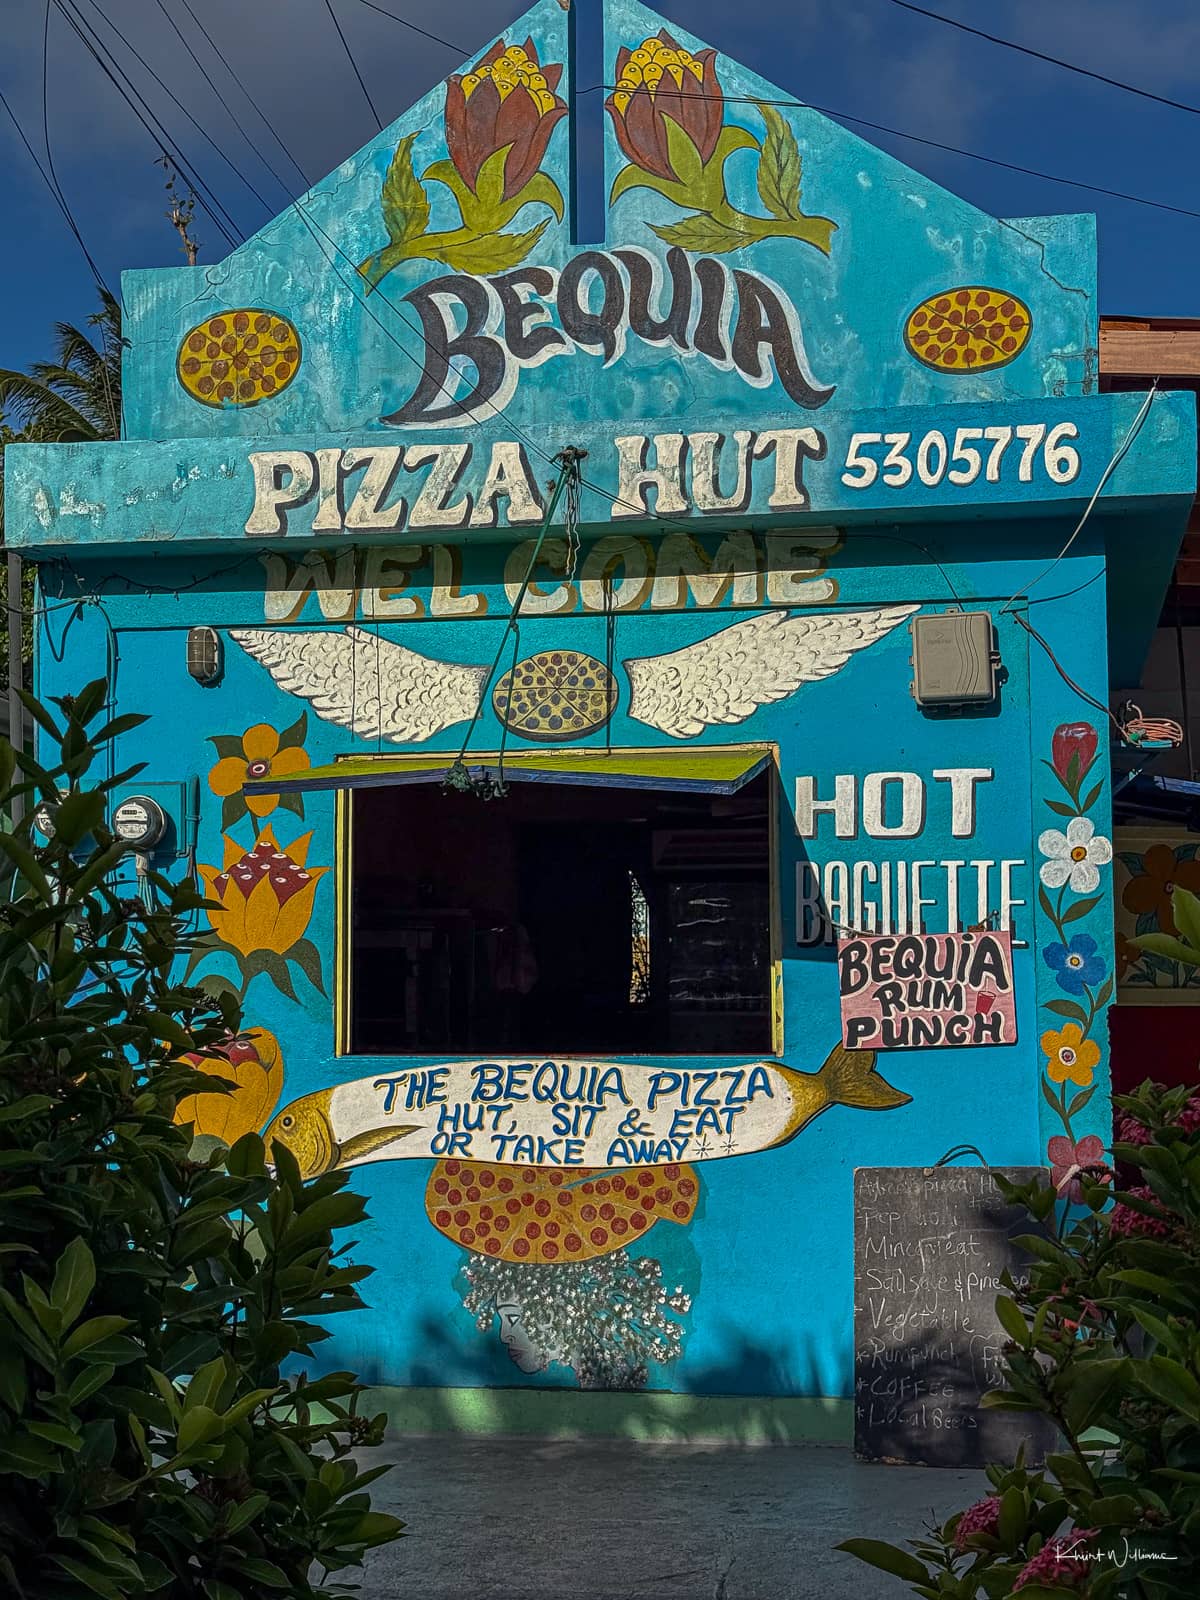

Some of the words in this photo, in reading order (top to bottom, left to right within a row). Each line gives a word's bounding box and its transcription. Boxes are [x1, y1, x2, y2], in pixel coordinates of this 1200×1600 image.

[379, 245, 837, 429] BEQUIA
[245, 442, 549, 535] PIZZA
[610, 427, 828, 520] HUT
[841, 422, 1082, 489] 5305776
[258, 527, 846, 621] WELCOME
[794, 767, 994, 839] HOT
[795, 859, 1026, 947] BAGUETTE
[845, 1010, 1009, 1048] PUNCH
[871, 980, 967, 1018] RUM
[373, 1067, 451, 1112] THE
[470, 1061, 633, 1107] BEQUIA
[647, 1066, 774, 1111] PIZZA
[430, 1131, 474, 1158] OR
[494, 1133, 586, 1165] TAKE
[606, 1137, 690, 1166] AWAY
[437, 1103, 517, 1136] HUT,
[552, 1102, 607, 1137] SIT
[617, 1108, 654, 1138] &
[670, 1105, 746, 1139] EAT
